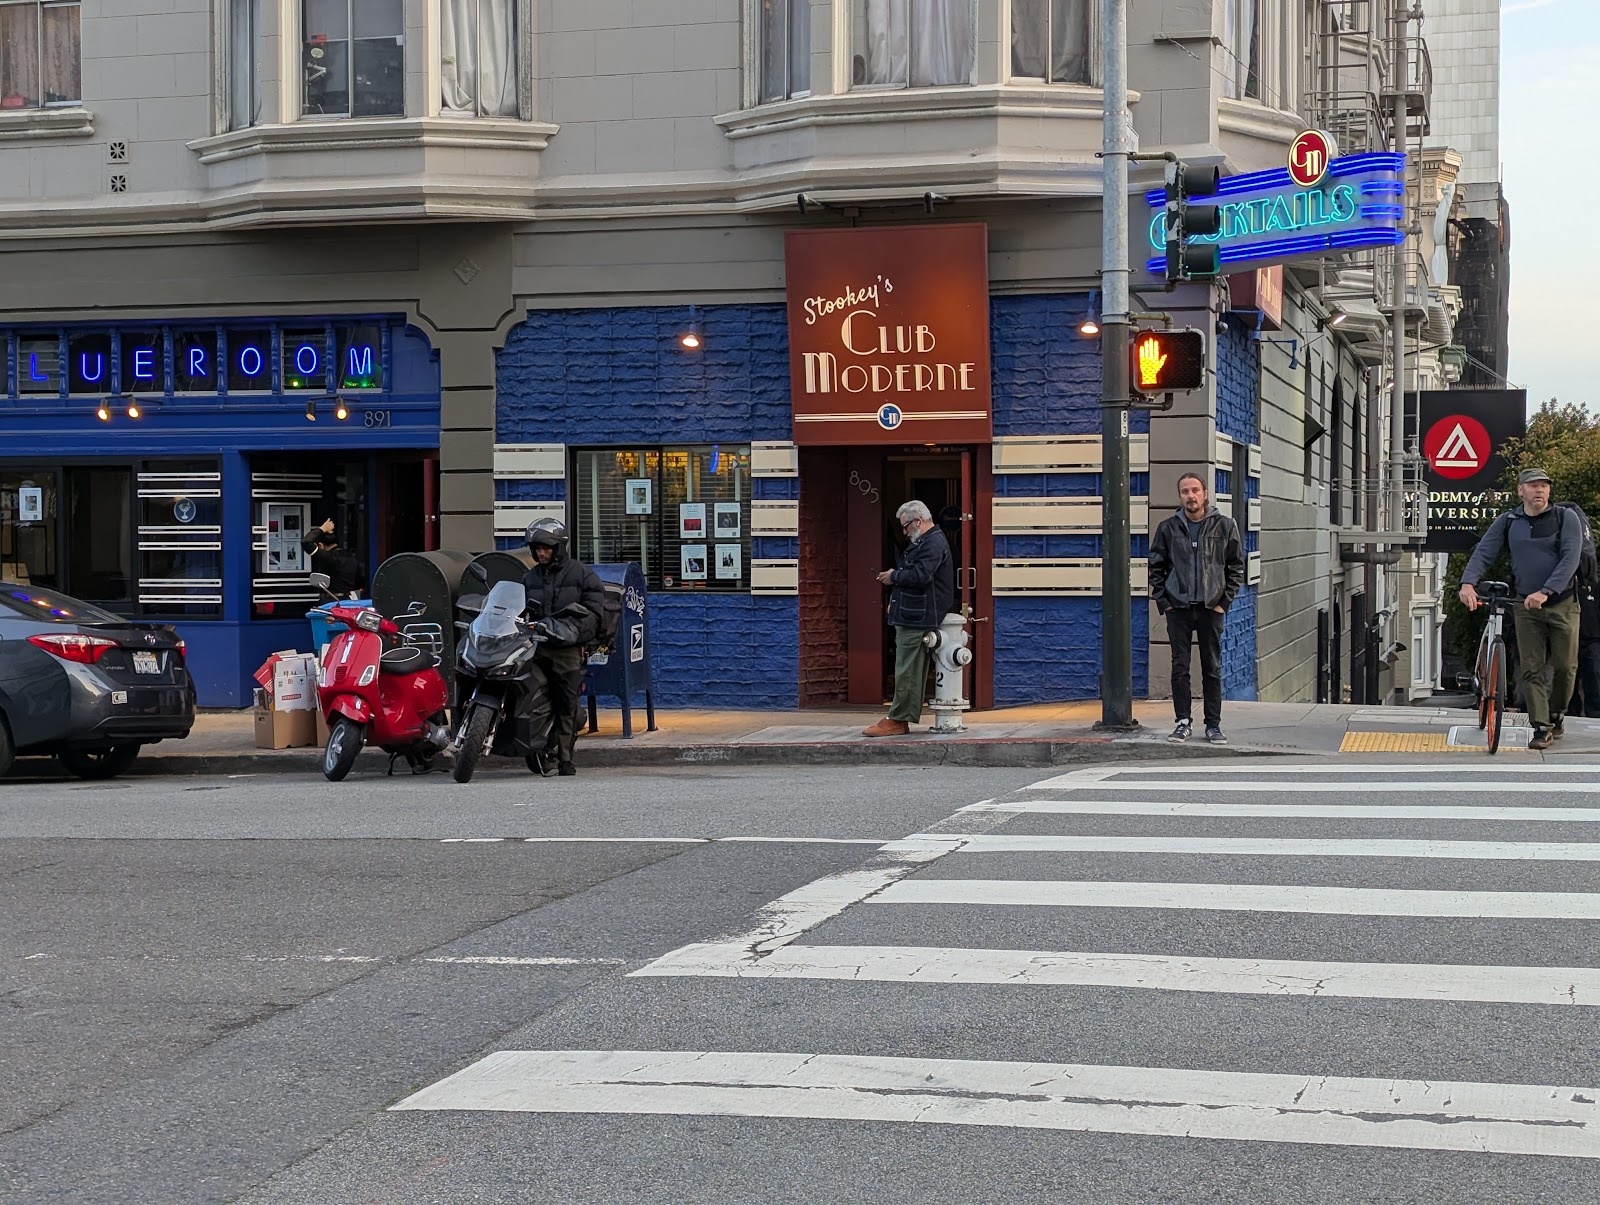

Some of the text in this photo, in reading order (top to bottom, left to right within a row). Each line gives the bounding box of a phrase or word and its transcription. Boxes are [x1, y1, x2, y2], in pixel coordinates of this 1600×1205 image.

[1150, 184, 1356, 250] CKTAILS
[803, 274, 893, 325] Stookey's
[841, 310, 936, 355] CLUB
[802, 352, 976, 393] MODERNE
[364, 410, 392, 428] 891
[850, 470, 879, 503] 895
[1402, 491, 1472, 502] ACDEMY
[1472, 492, 1485, 505] of
[1401, 507, 1512, 519] UIVERSIT
[936, 672, 944, 687] 2
